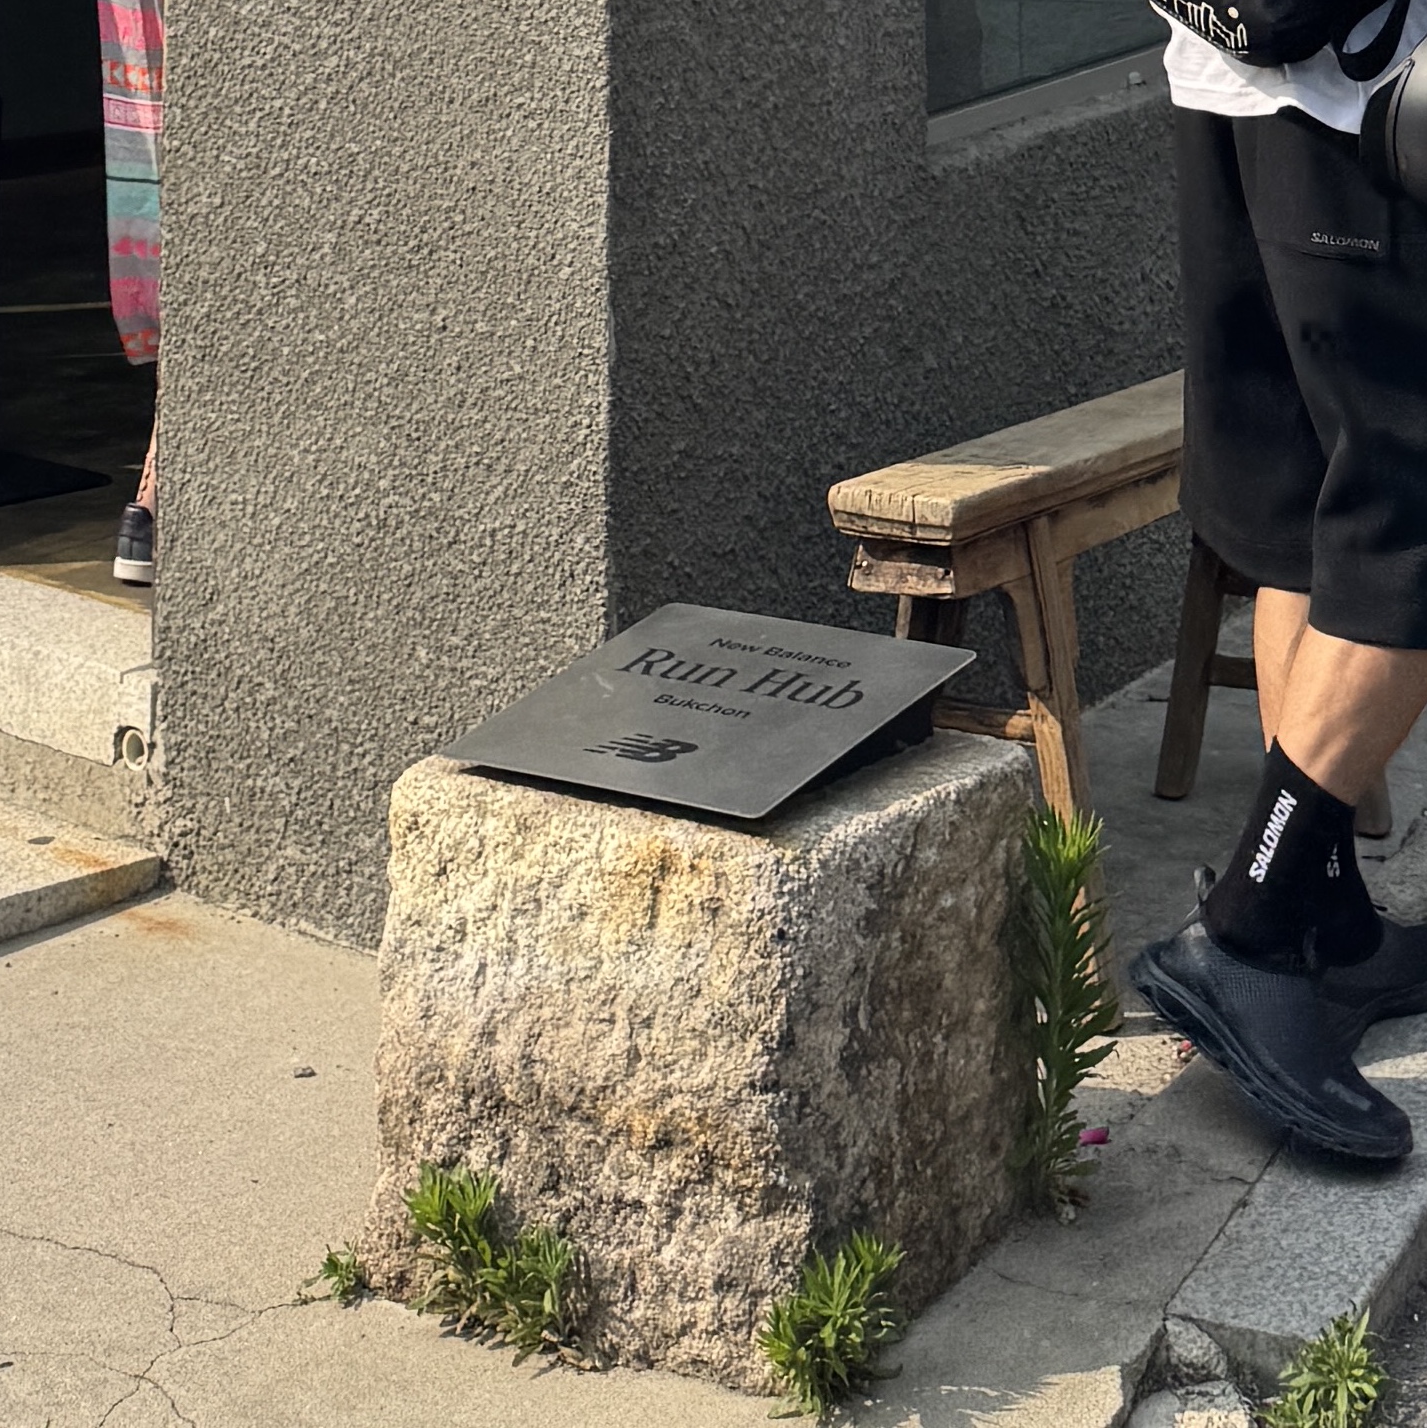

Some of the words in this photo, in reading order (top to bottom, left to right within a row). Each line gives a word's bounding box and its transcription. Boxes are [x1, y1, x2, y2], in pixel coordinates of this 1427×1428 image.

[1310, 231, 1380, 251] SALOMON
[708, 637, 762, 654] New
[762, 645, 852, 670] Balance
[614, 646, 738, 689] Run
[739, 666, 865, 710] Hub
[652, 693, 753, 720] Bukchon
[1248, 788, 1298, 884] SALOMON
